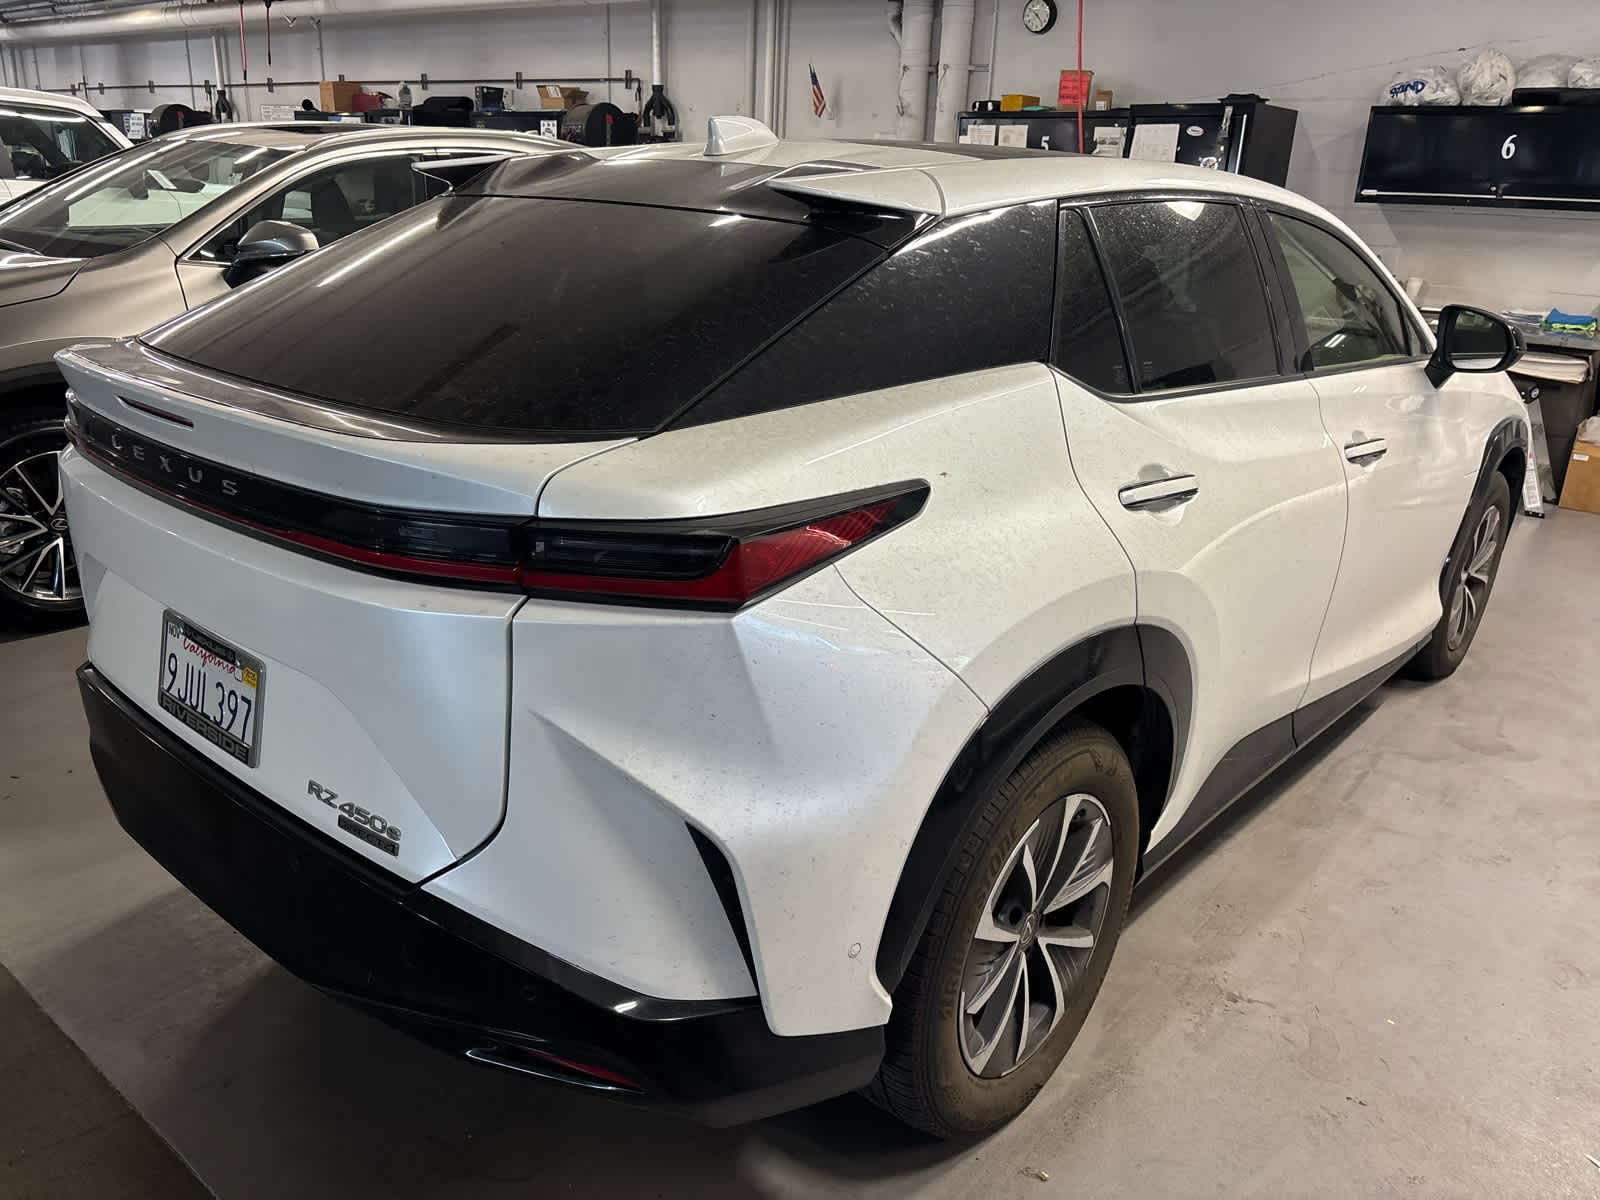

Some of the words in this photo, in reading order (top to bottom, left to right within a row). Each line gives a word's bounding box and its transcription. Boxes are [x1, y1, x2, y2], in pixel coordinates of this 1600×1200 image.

[1041, 135, 1050, 151] 5
[1501, 134, 1518, 160] 6
[111, 433, 239, 496] LEXUS
[161, 696, 249, 763] RIVERSIDE
